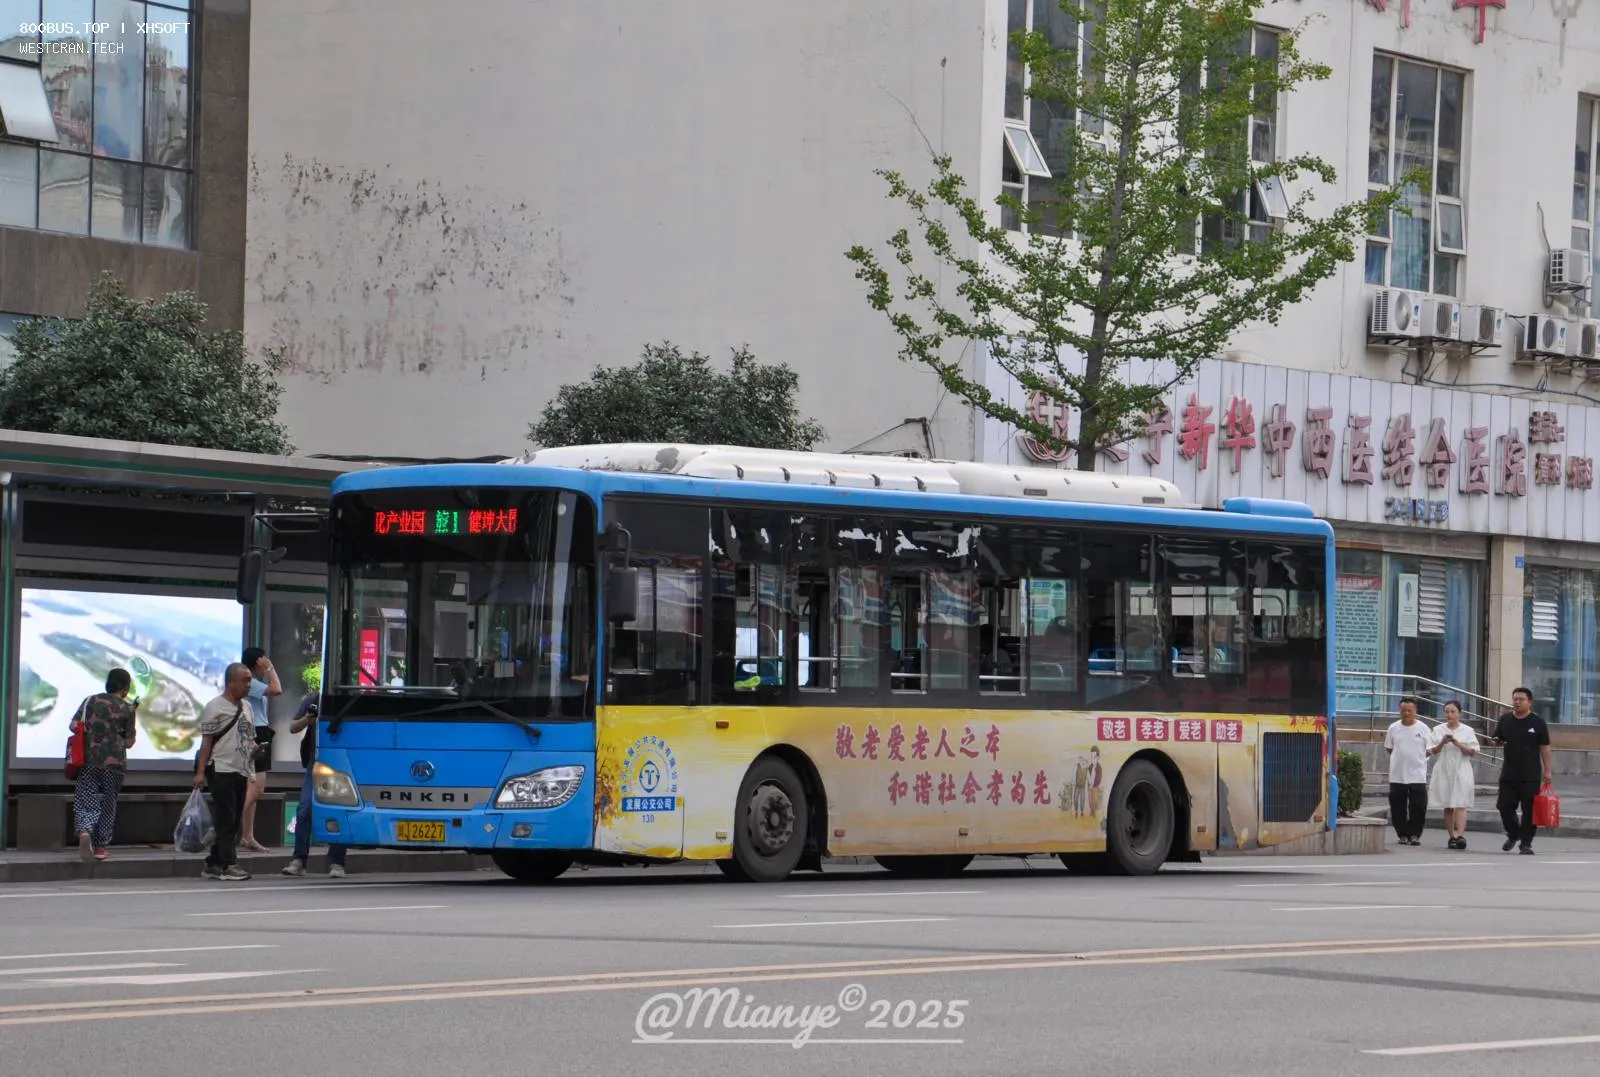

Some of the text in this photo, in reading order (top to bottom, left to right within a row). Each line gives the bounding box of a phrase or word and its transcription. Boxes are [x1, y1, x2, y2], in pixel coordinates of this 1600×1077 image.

[1096, 392, 1527, 498] 宁新华中西医结合医院
[835, 724, 1000, 762] 敬老爱老人之本
[1102, 719, 1237, 741] 敬老 孝老 爱老 助老
[380, 790, 469, 803] ANKAI
[887, 769, 1051, 806] 和谐社会孝为先
